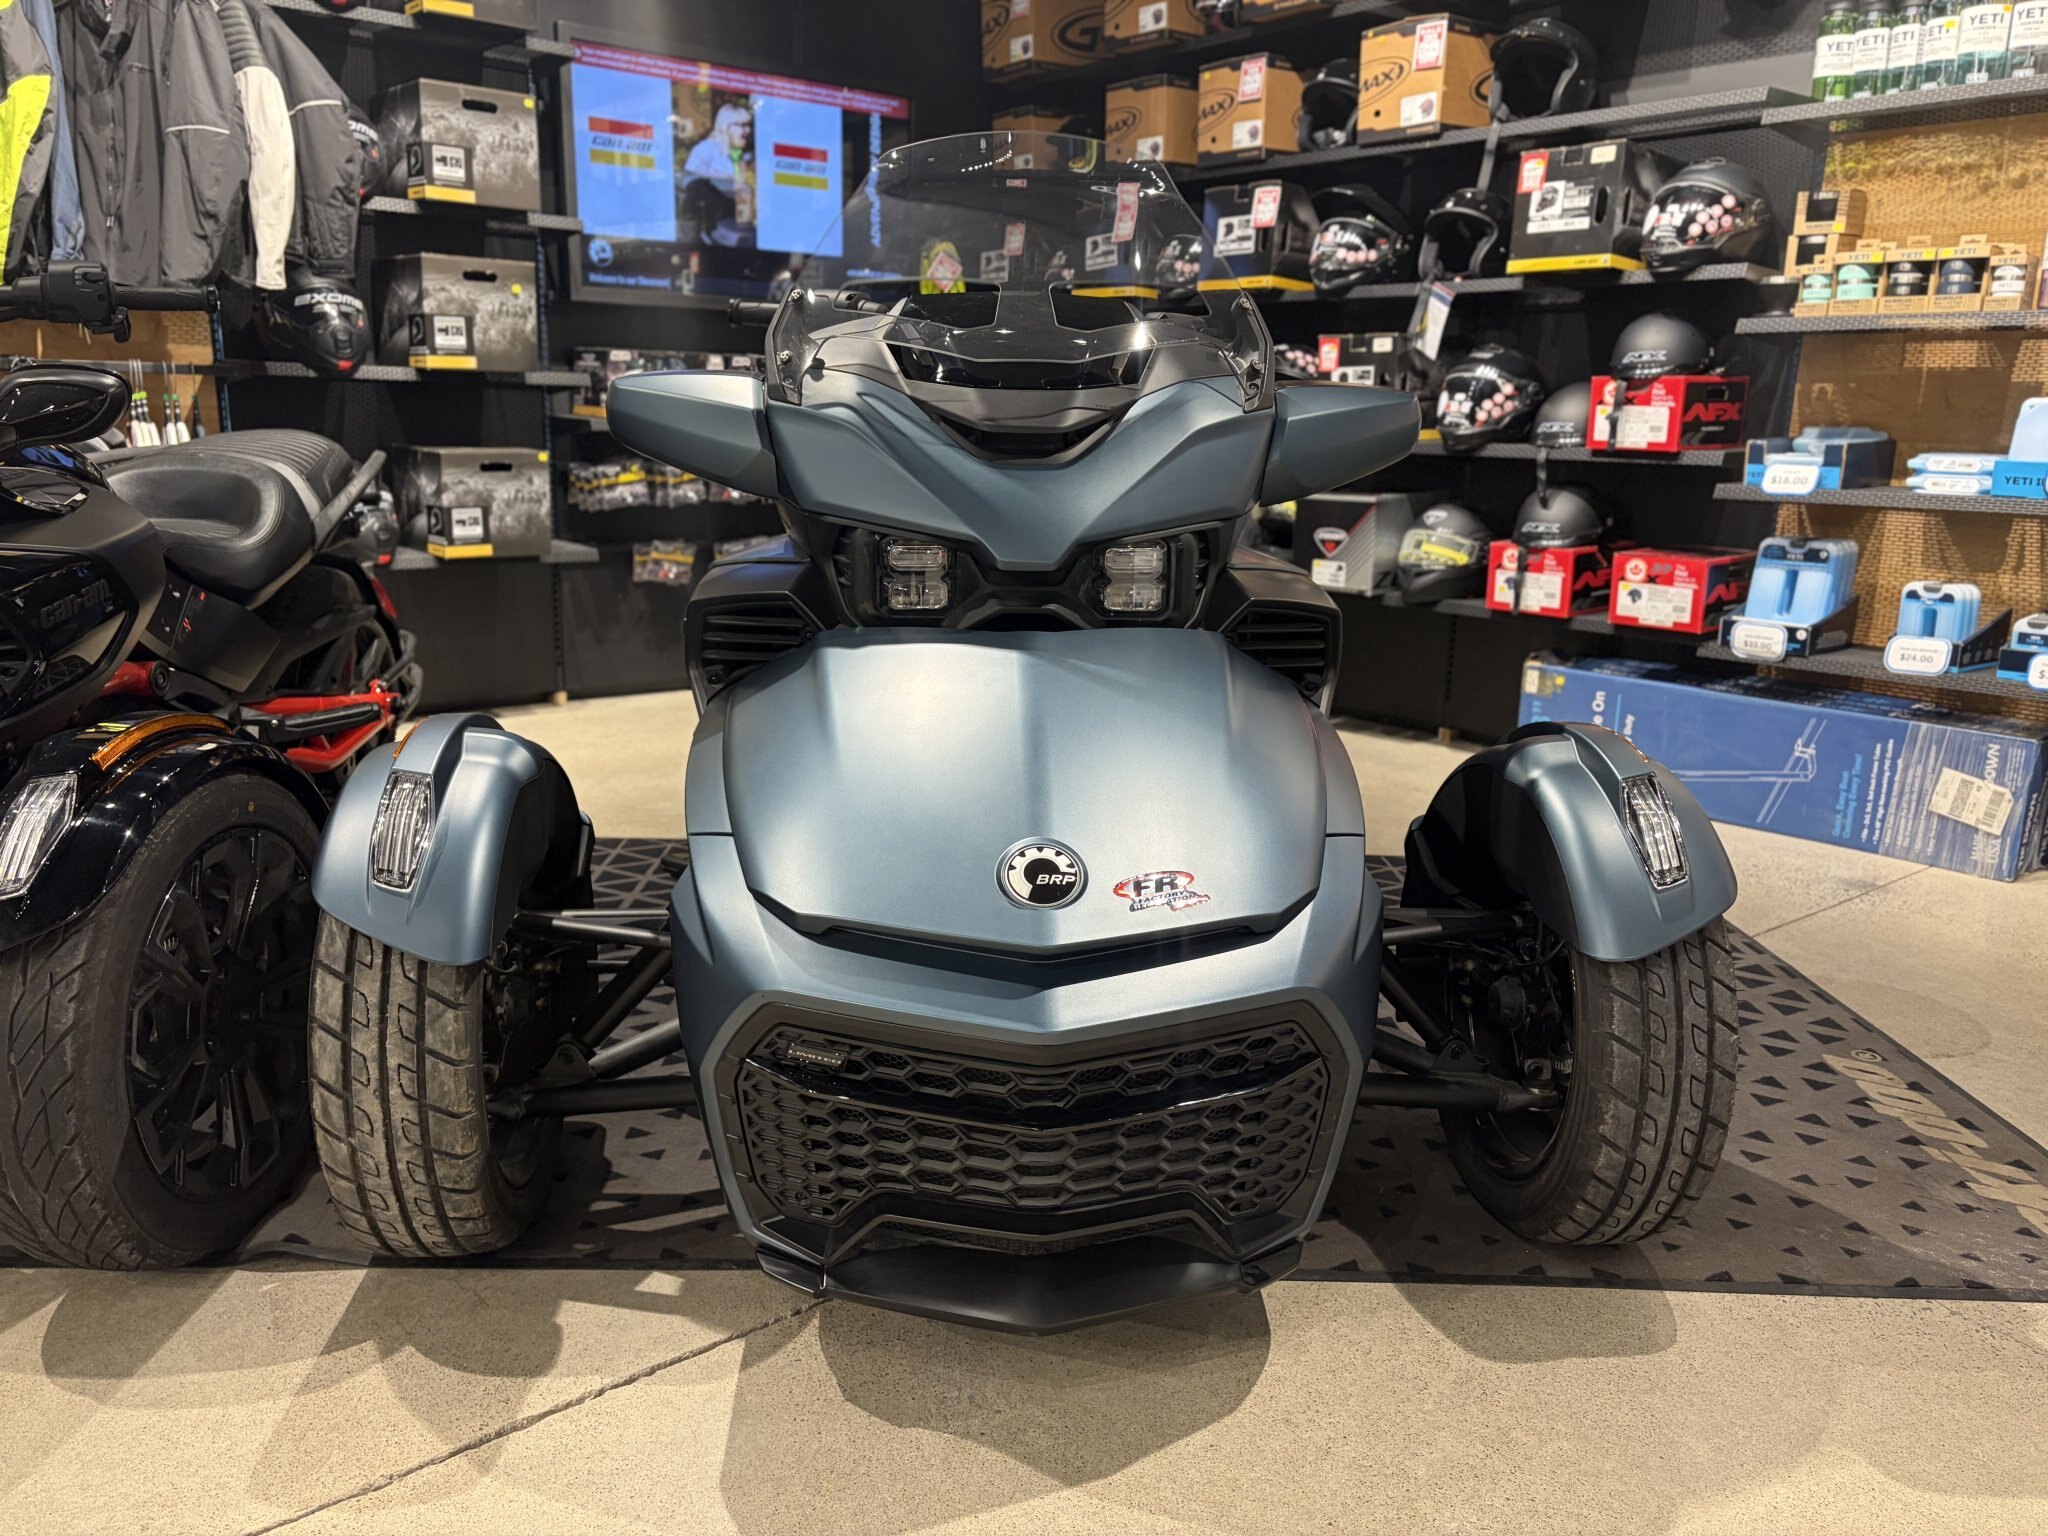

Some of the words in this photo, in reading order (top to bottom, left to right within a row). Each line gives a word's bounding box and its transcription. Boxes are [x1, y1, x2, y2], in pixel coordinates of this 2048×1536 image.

[1969, 13, 2005, 26] YETI
[2017, 7, 2048, 20] YET
[1894, 30, 1915, 43] ETI
[1827, 41, 1853, 52] YET
[1682, 402, 1743, 422] AFX
[2004, 476, 2033, 486] YETI
[1786, 553, 1804, 561] YETI
[1900, 653, 1934, 664] $24.00
[1849, 777, 1860, 799] Every
[1036, 874, 1076, 886] BRP
[1133, 876, 1179, 898] FR
[1137, 890, 1186, 905] FACTORY
[788, 1049, 843, 1065] LIMITED
